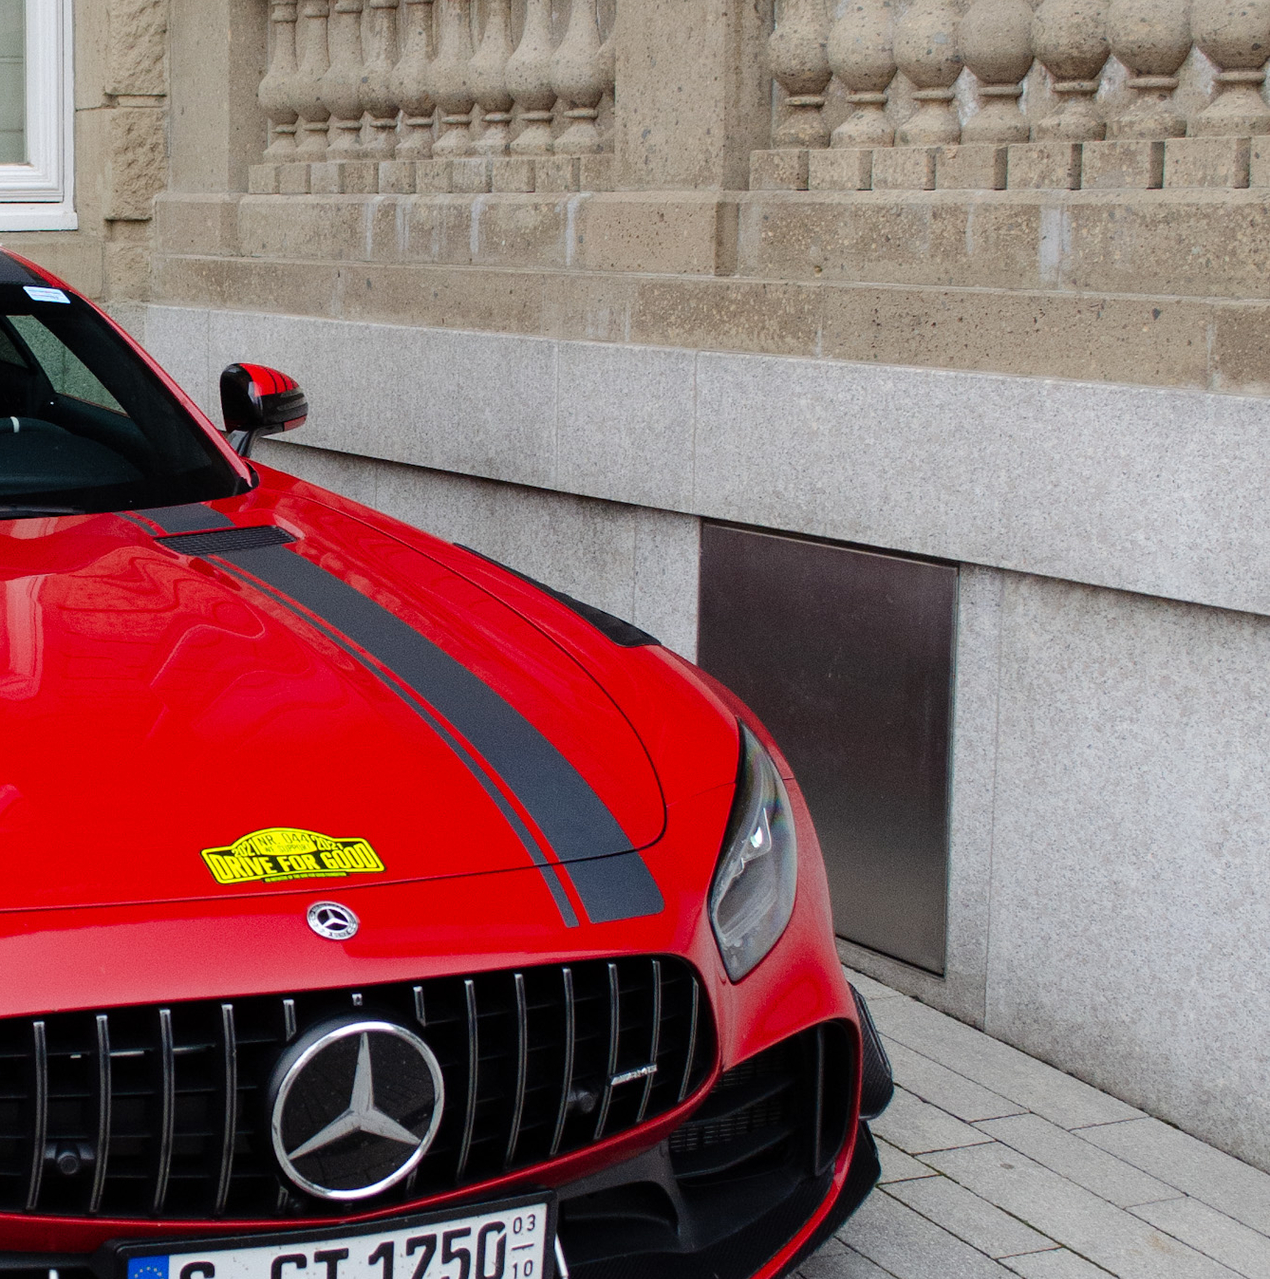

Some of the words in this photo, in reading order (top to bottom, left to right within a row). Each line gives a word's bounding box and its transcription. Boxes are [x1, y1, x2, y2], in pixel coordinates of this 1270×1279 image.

[281, 832, 312, 845] 044
[310, 835, 343, 851] 2021
[232, 839, 260, 858] 2021
[208, 853, 277, 880] DRIVE
[277, 853, 321, 873] FOR
[320, 843, 378, 869] GOOD
[512, 1213, 537, 1235] 03
